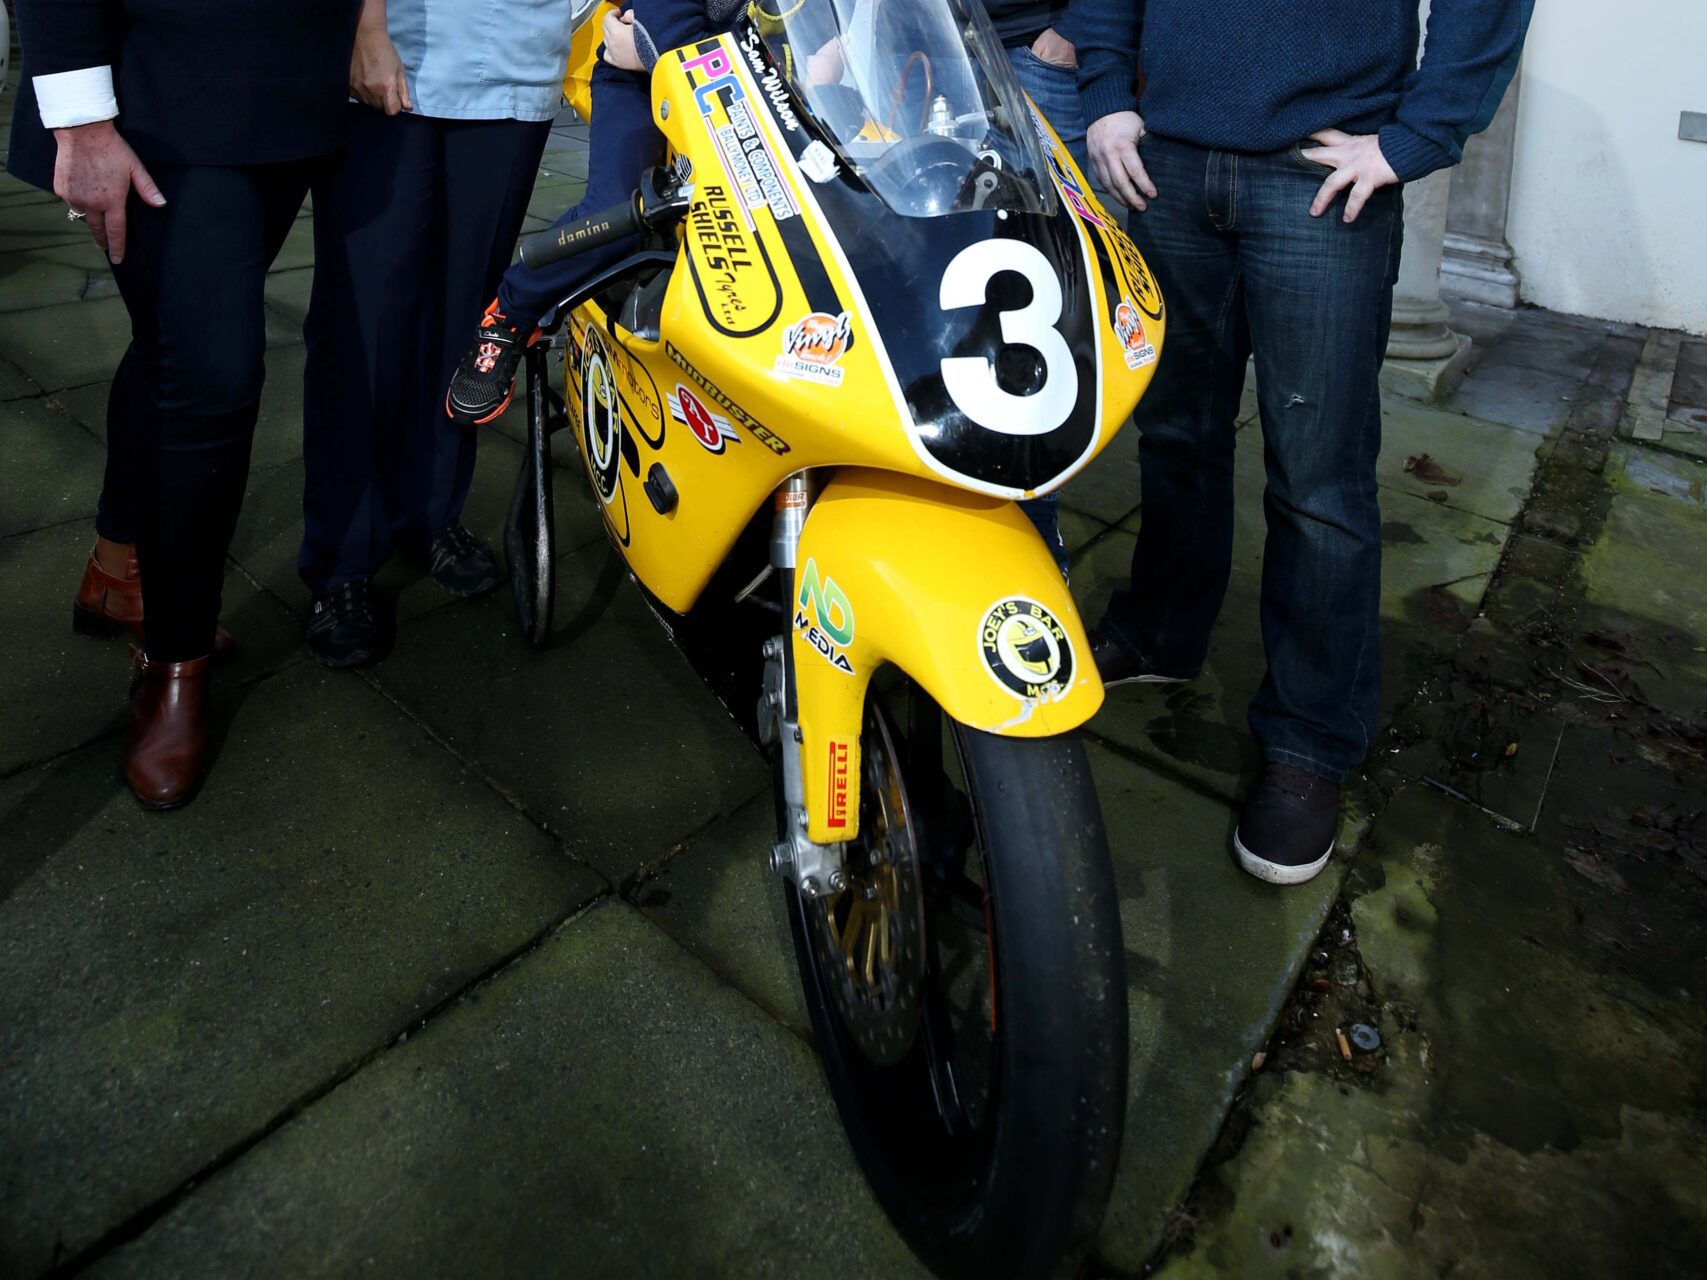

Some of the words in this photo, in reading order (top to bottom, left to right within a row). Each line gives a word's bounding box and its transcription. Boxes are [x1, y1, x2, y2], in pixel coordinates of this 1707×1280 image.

[683, 47, 745, 116] PC
[740, 33, 766, 74] Sam
[761, 67, 800, 132] Wilson
[730, 104, 755, 140] PAINTS
[744, 137, 759, 152] &
[749, 151, 792, 219] COMPONENTS
[558, 220, 609, 245] domino
[691, 202, 730, 270] SHIELS
[704, 186, 752, 272] RUSSELL
[939, 237, 1079, 436] 3
[667, 344, 787, 454] MUDBUSTER
[795, 611, 854, 674] MEDIA
[983, 602, 1019, 653] JOEY'S
[1029, 605, 1064, 641] BAR
[828, 741, 848, 828] PIRELLI
